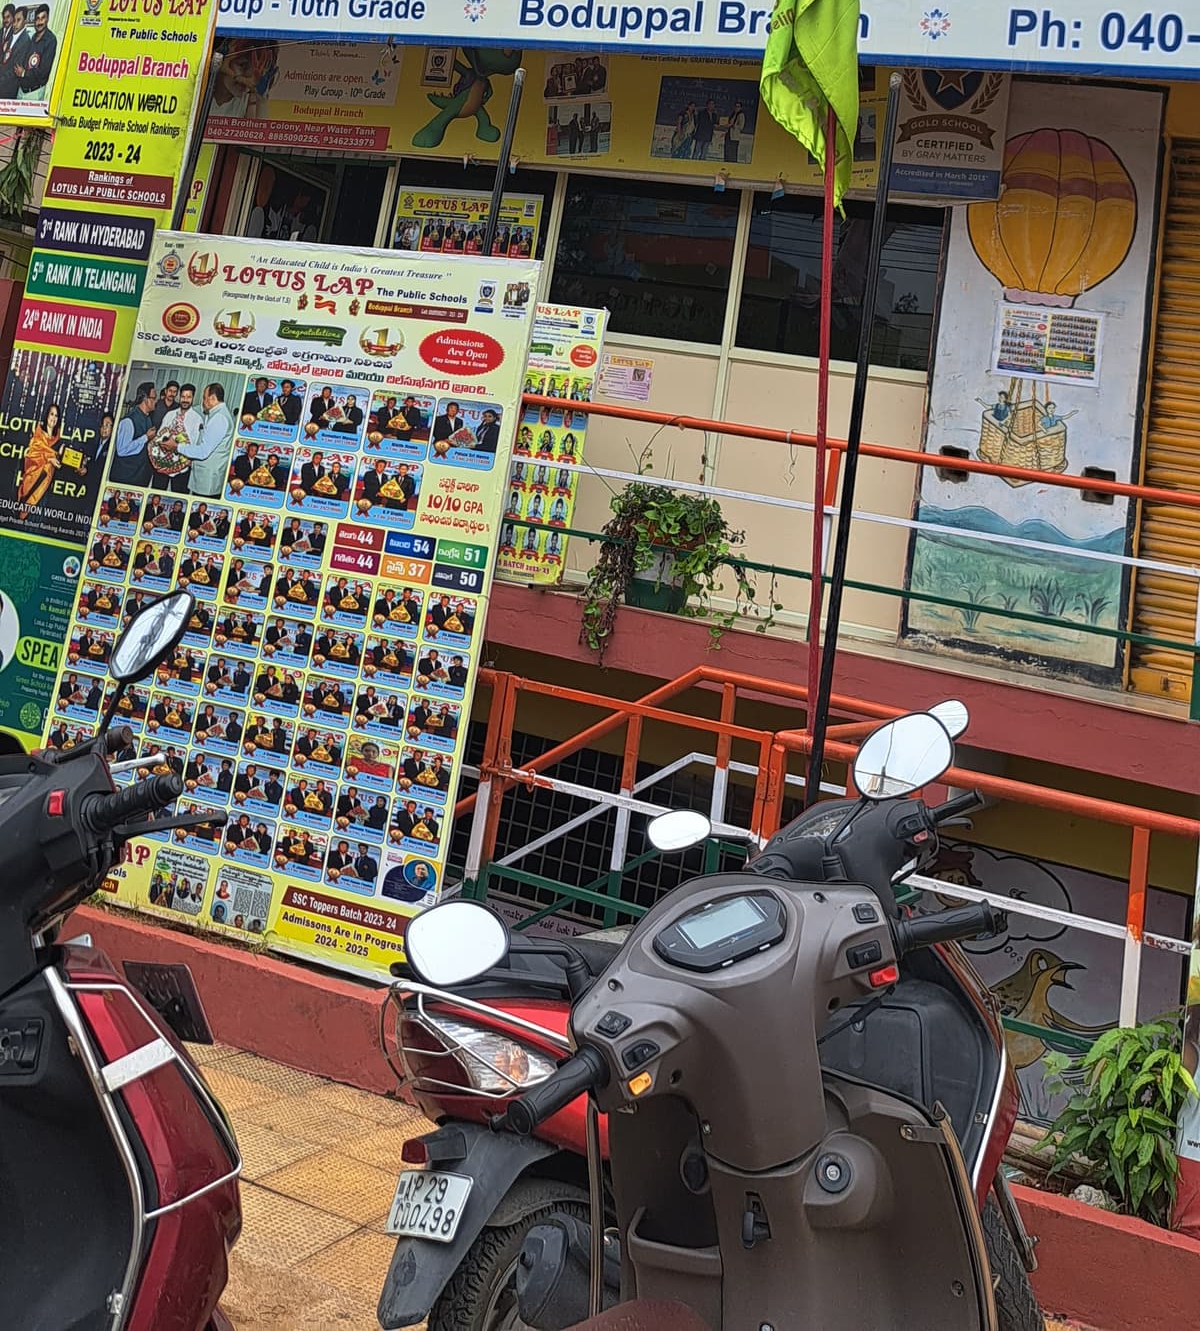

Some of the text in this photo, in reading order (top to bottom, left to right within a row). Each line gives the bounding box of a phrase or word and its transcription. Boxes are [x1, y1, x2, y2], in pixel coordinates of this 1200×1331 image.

[110, 27, 198, 43] The Public Schools
[1007, 8, 1082, 49] Ph:
[78, 52, 189, 79] Boduppal Branch
[284, 70, 326, 82] Admissions
[328, 74, 341, 82] are
[72, 88, 178, 114] EDUCATION WORLD
[304, 85, 320, 98] Play
[320, 86, 343, 100] Group
[363, 88, 386, 100] Grade
[293, 104, 364, 118] Boduppal Branch
[78, 116, 102, 131] Budget
[102, 117, 125, 132] Private
[126, 119, 149, 134] School
[150, 121, 181, 139] Rankings
[231, 118, 267, 129] Brothers
[304, 123, 325, 133] Near
[327, 125, 353, 135] Water
[355, 126, 376, 136] Tank
[911, 119, 983, 134] GOLD SCHOOL
[84, 140, 115, 162] 2023
[125, 143, 141, 165] 24
[916, 139, 974, 151] CERTIFIED
[902, 149, 986, 163] BY GRAY MATTERS
[88, 170, 133, 186] Rankings of
[944, 171, 967, 180] March
[51, 183, 166, 204] LOTUS LAP PUBLIC SCHOOLS
[418, 197, 489, 213] LOTUS LAP
[40, 219, 146, 251] 3rd RANK IN HYDERABAD
[256, 256, 443, 280] An Educated Child is India's Greatest Treasure
[32, 260, 44, 282] 5th
[45, 262, 70, 286] RANK
[71, 266, 83, 287] IN
[84, 268, 137, 295] TELANGANA
[223, 264, 374, 296] LOTUS LAP
[376, 286, 468, 304] The Public Schools
[368, 302, 393, 314] Boduppal
[393, 304, 413, 314] Branch
[22, 308, 103, 340] 24th RANK IN INDIA
[137, 331, 160, 342] SSC
[214, 340, 246, 352] 100%
[436, 335, 485, 348] Admissions
[448, 347, 488, 360] Are Open
[60, 422, 96, 443] LAP
[0, 498, 92, 525] EDUCATION WORLD INDI
[426, 493, 484, 515] 10/10 GPA
[357, 529, 374, 545] 44
[413, 539, 430, 555] 54
[464, 547, 481, 563] 51
[356, 553, 374, 570] 44
[408, 563, 426, 578] 37
[459, 571, 477, 588] 50
[22, 639, 62, 668] SPEA
[292, 891, 308, 907] SSC
[309, 897, 338, 915] Toppers
[340, 904, 362, 921] Batch
[386, 916, 397, 930] 24
[282, 911, 332, 933] Admissons
[334, 925, 351, 938] Are
[314, 933, 337, 949] 2024
[345, 942, 369, 957] 2025
[403, 1174, 449, 1204] AP 29
